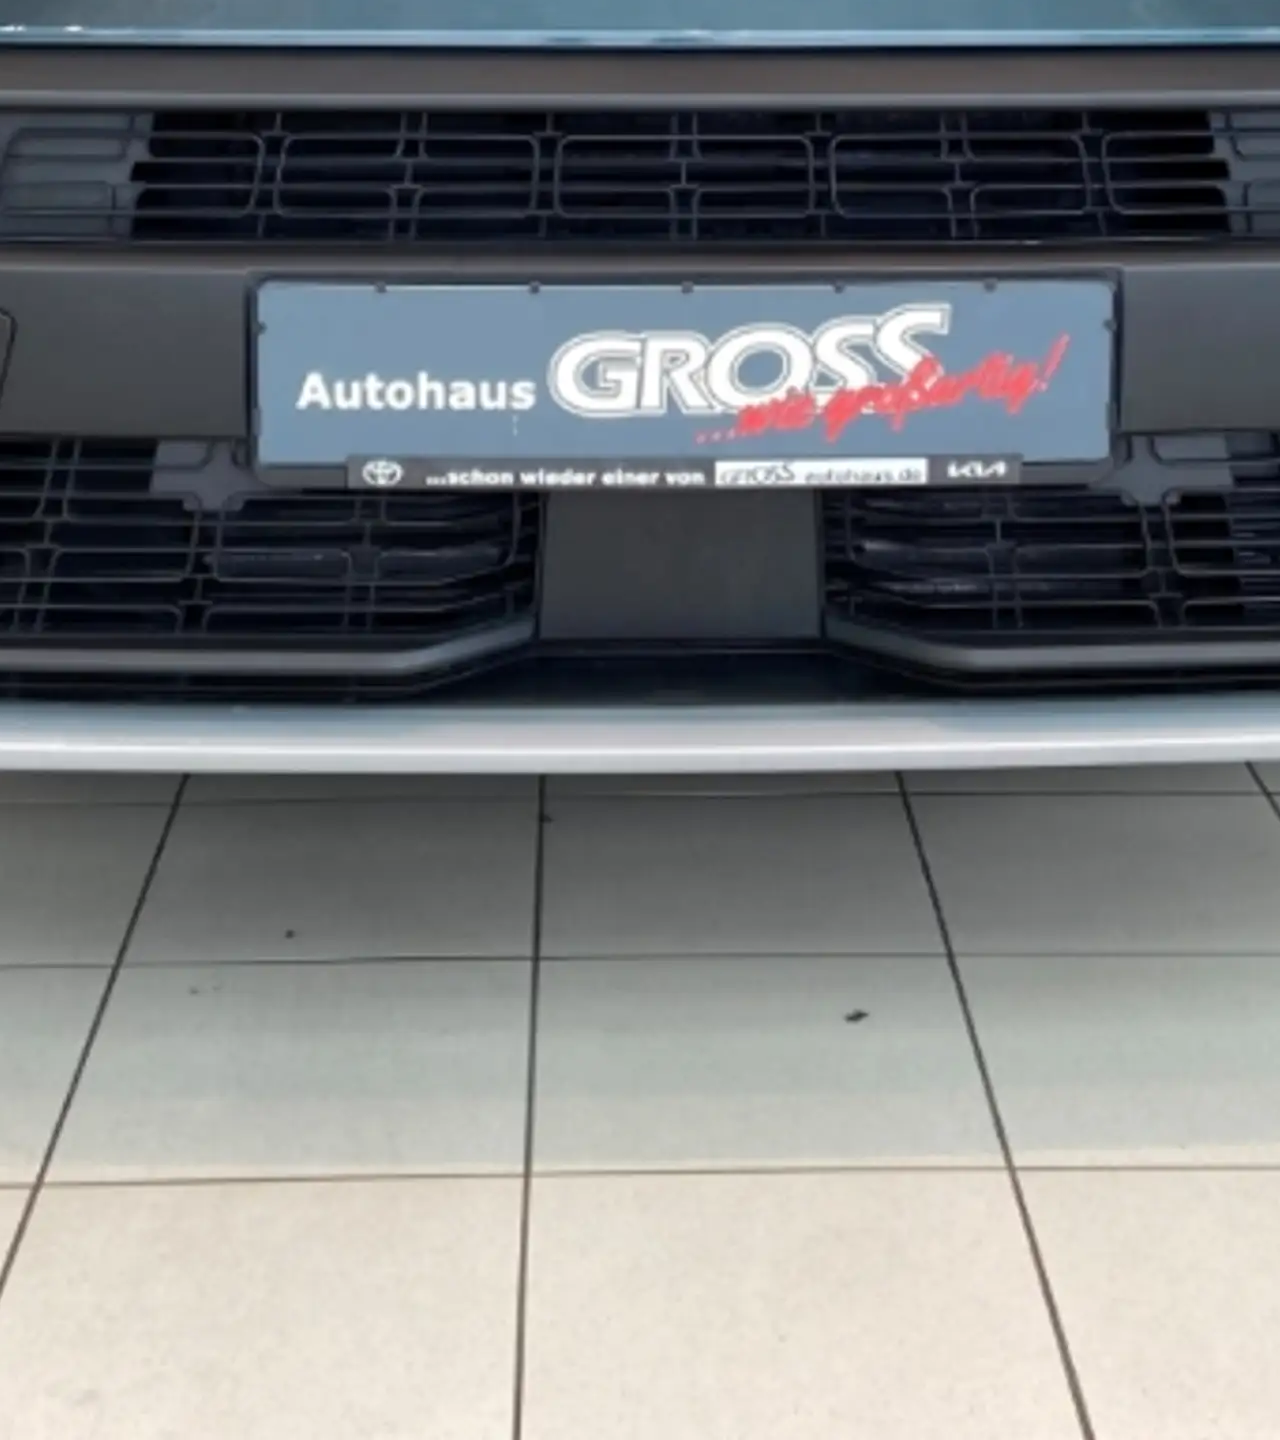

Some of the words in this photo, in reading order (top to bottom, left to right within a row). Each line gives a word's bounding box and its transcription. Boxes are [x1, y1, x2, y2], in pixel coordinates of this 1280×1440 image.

[295, 371, 536, 411] Autohaus
[546, 303, 952, 417] GROSS
[520, 467, 596, 486] wieder
[602, 467, 660, 486] einer
[665, 470, 705, 486] von
